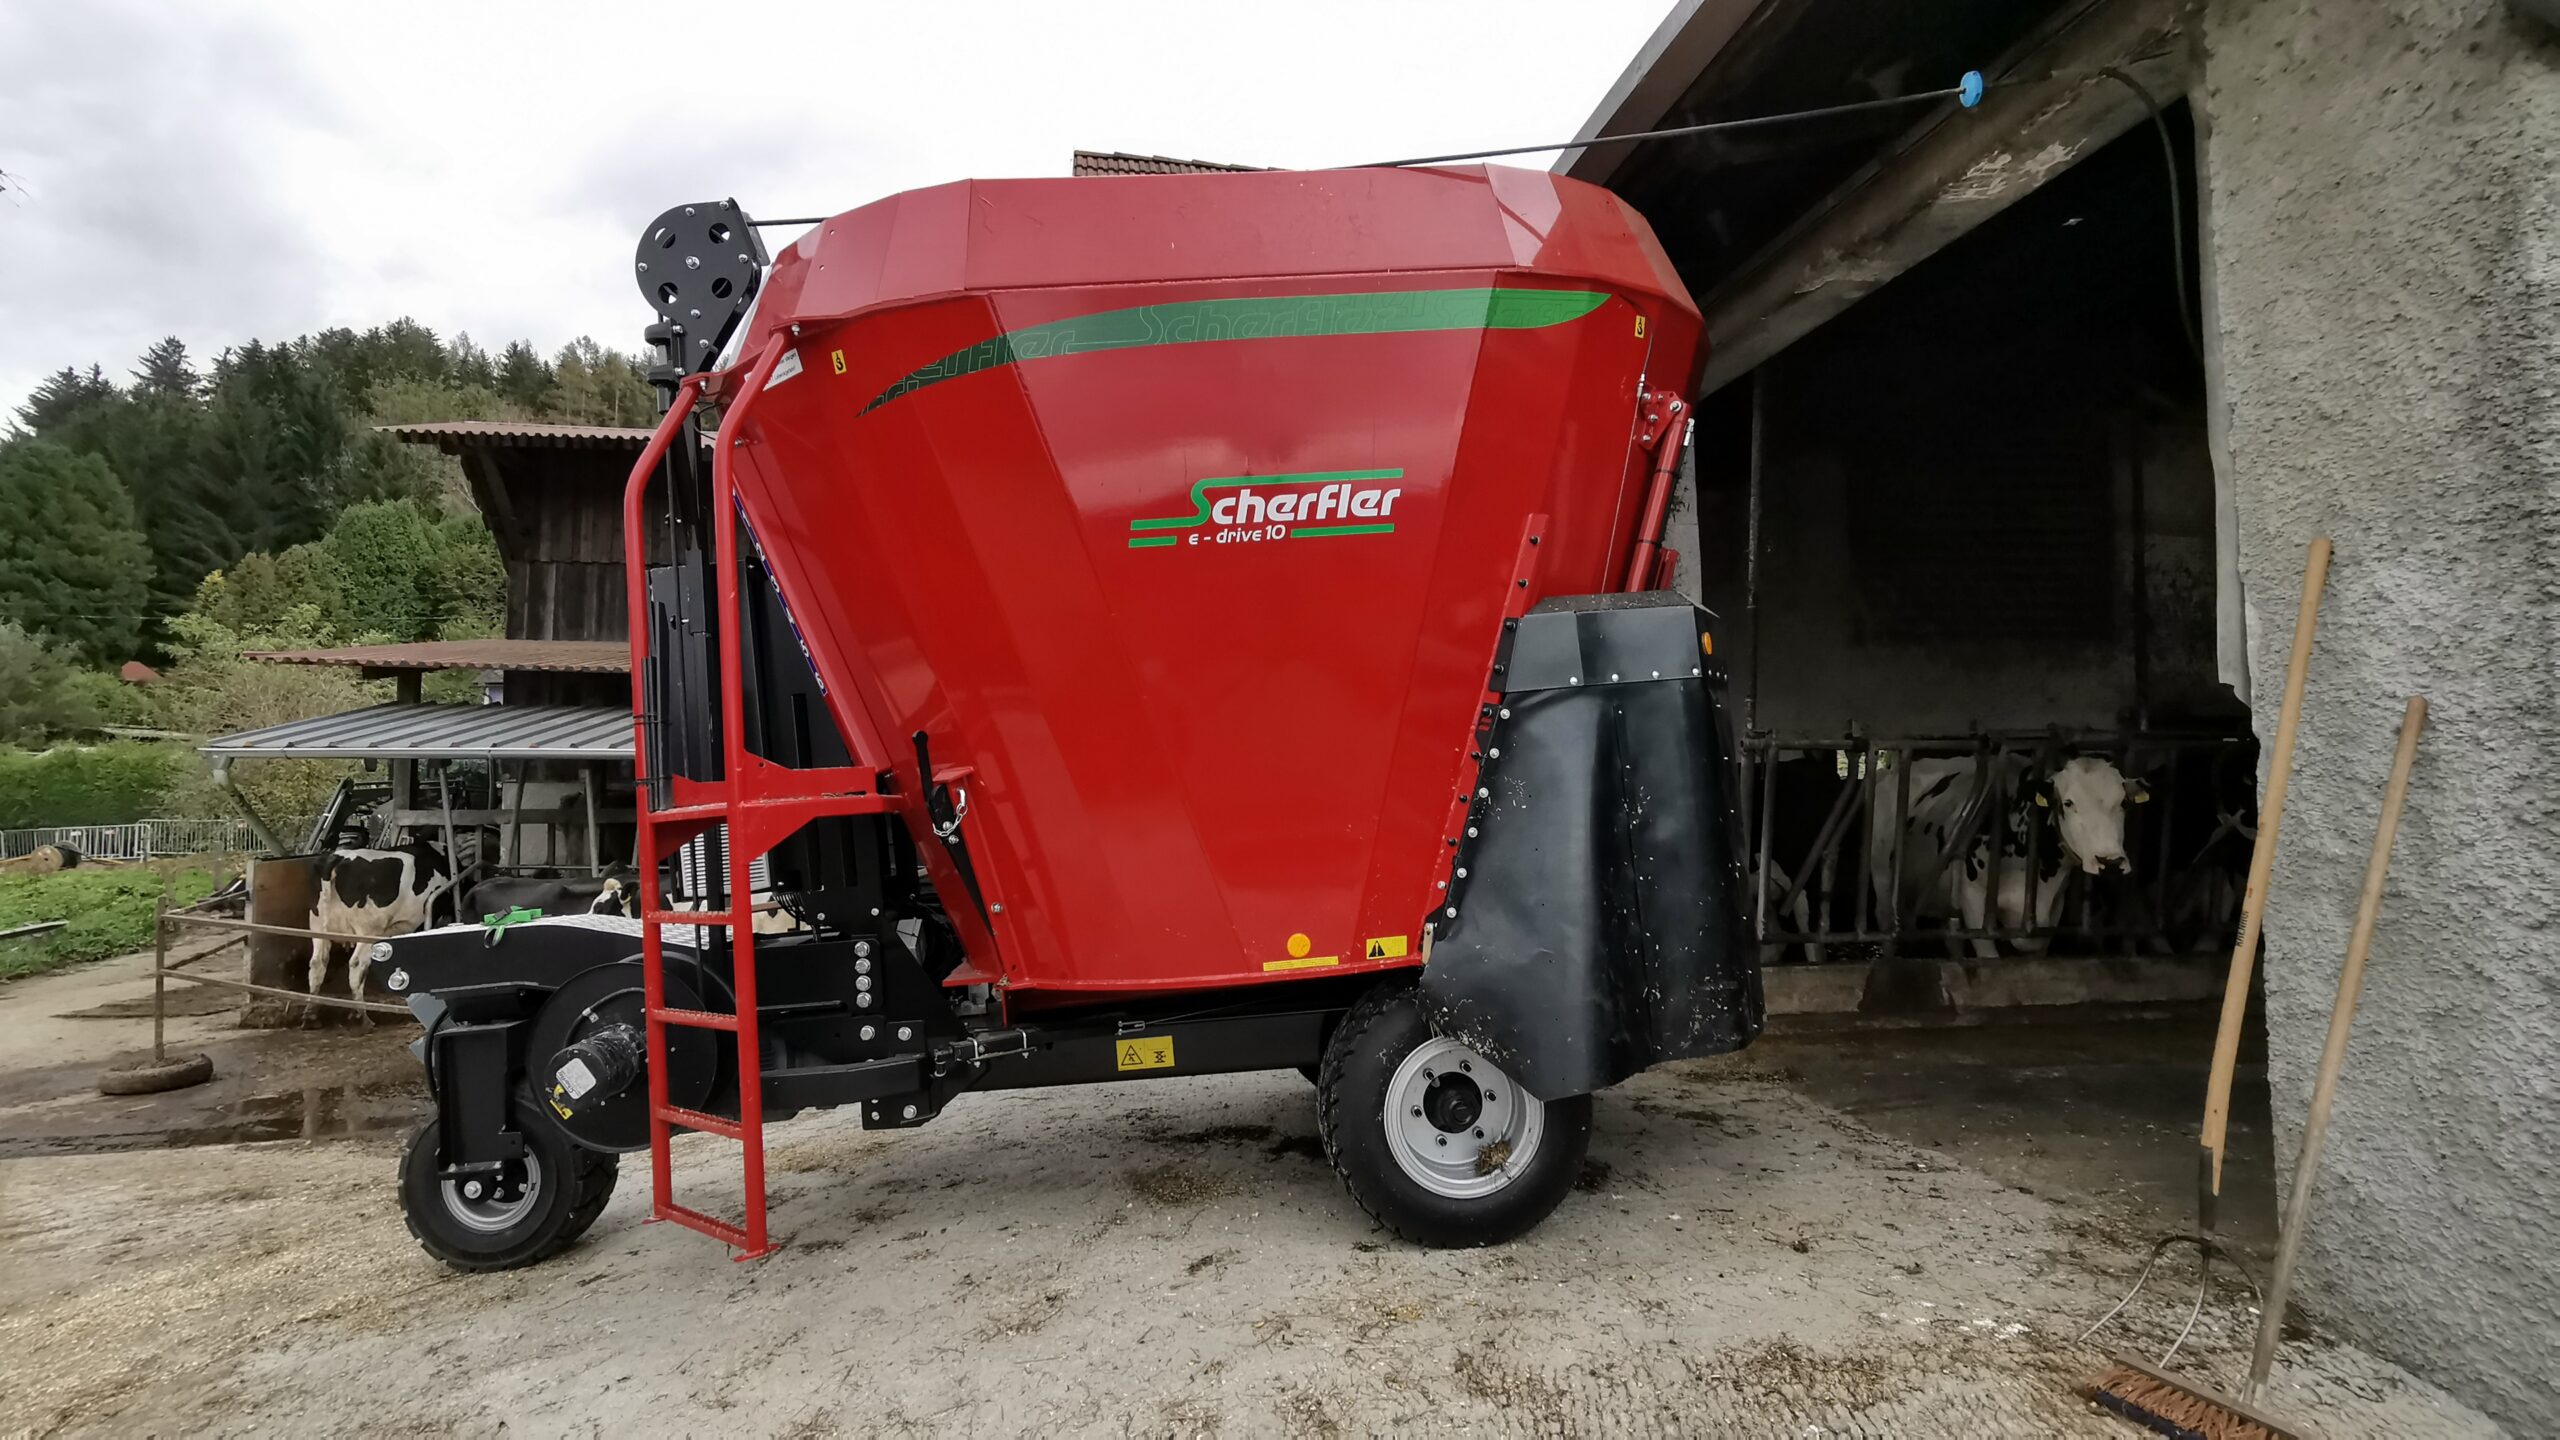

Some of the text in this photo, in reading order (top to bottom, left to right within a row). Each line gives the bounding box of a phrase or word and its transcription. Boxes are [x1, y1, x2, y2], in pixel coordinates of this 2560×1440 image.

[1190, 468, 1403, 527] Scherfler
[1189, 534, 1199, 545] e
[1216, 526, 1262, 544] drive
[1265, 524, 1287, 540] 10
